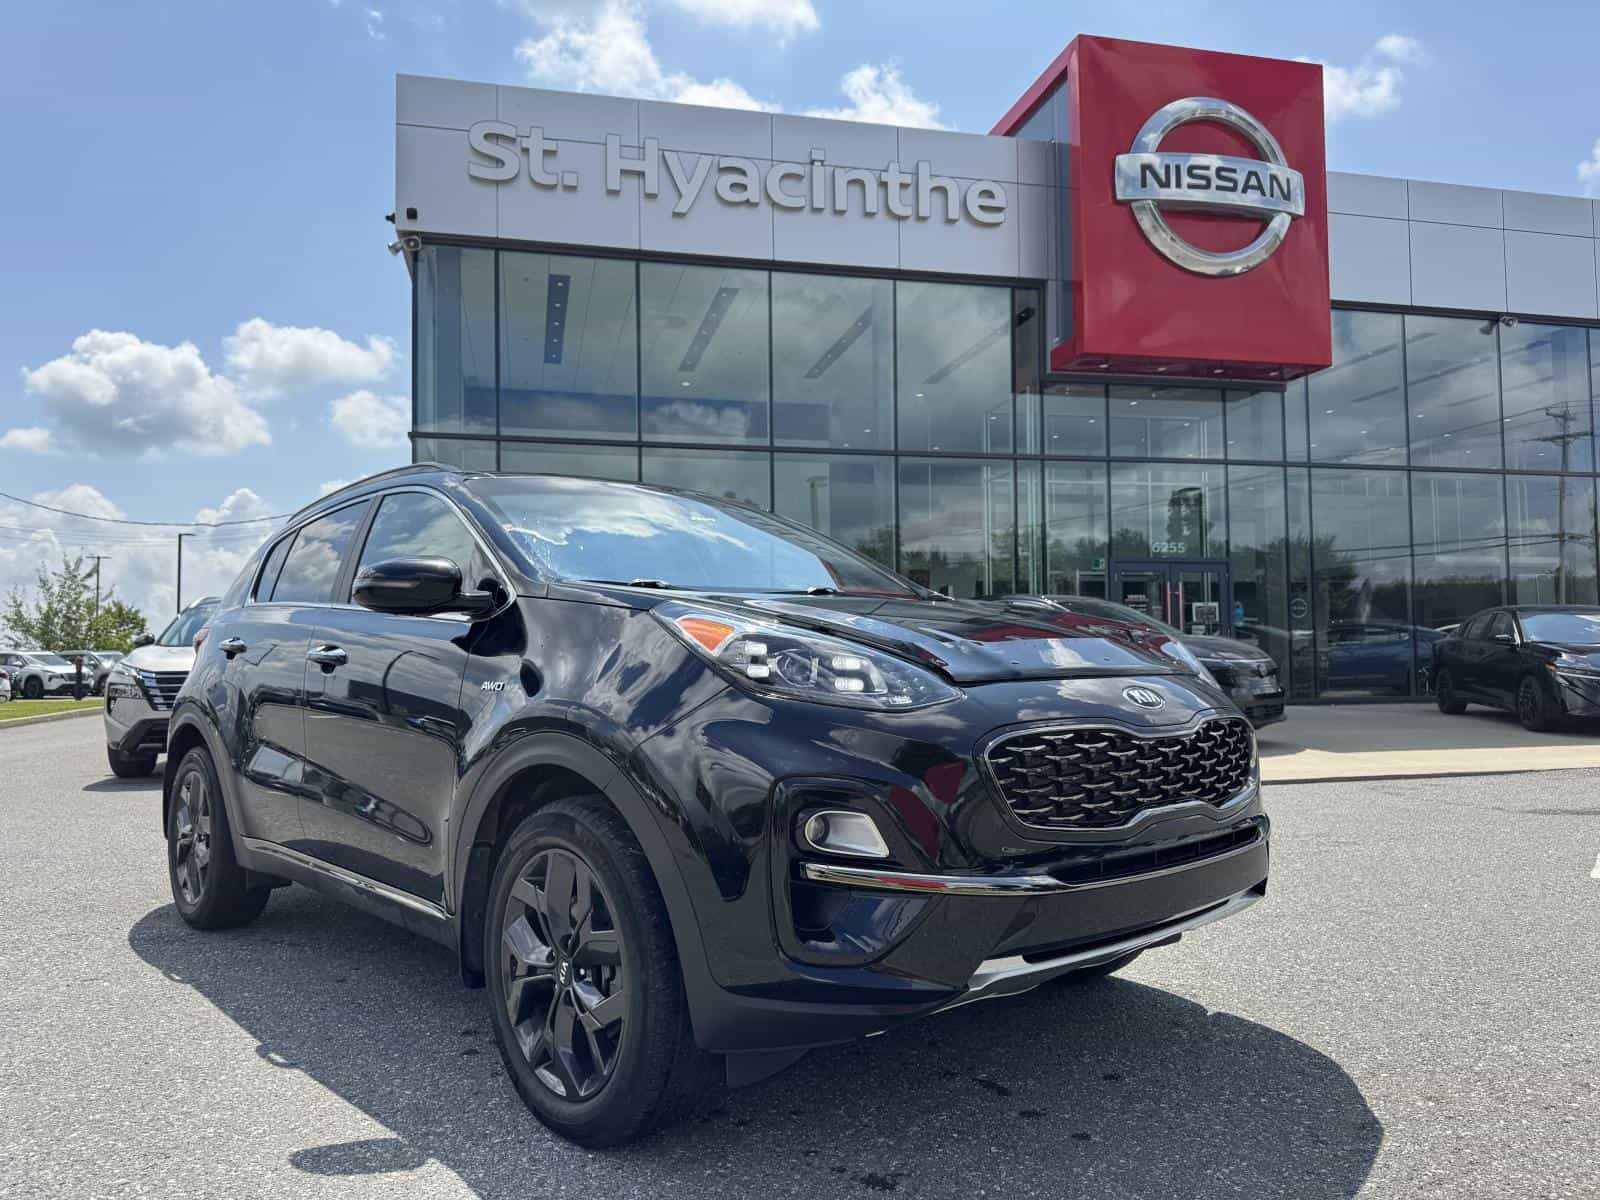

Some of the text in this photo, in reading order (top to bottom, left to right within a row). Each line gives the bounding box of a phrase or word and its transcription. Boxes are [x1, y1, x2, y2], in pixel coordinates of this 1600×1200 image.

[468, 120, 1008, 225] St. Hyacinthe
[1140, 163, 1292, 202] NISSAN
[1152, 542, 1185, 553] 6255
[481, 681, 505, 691] AWD
